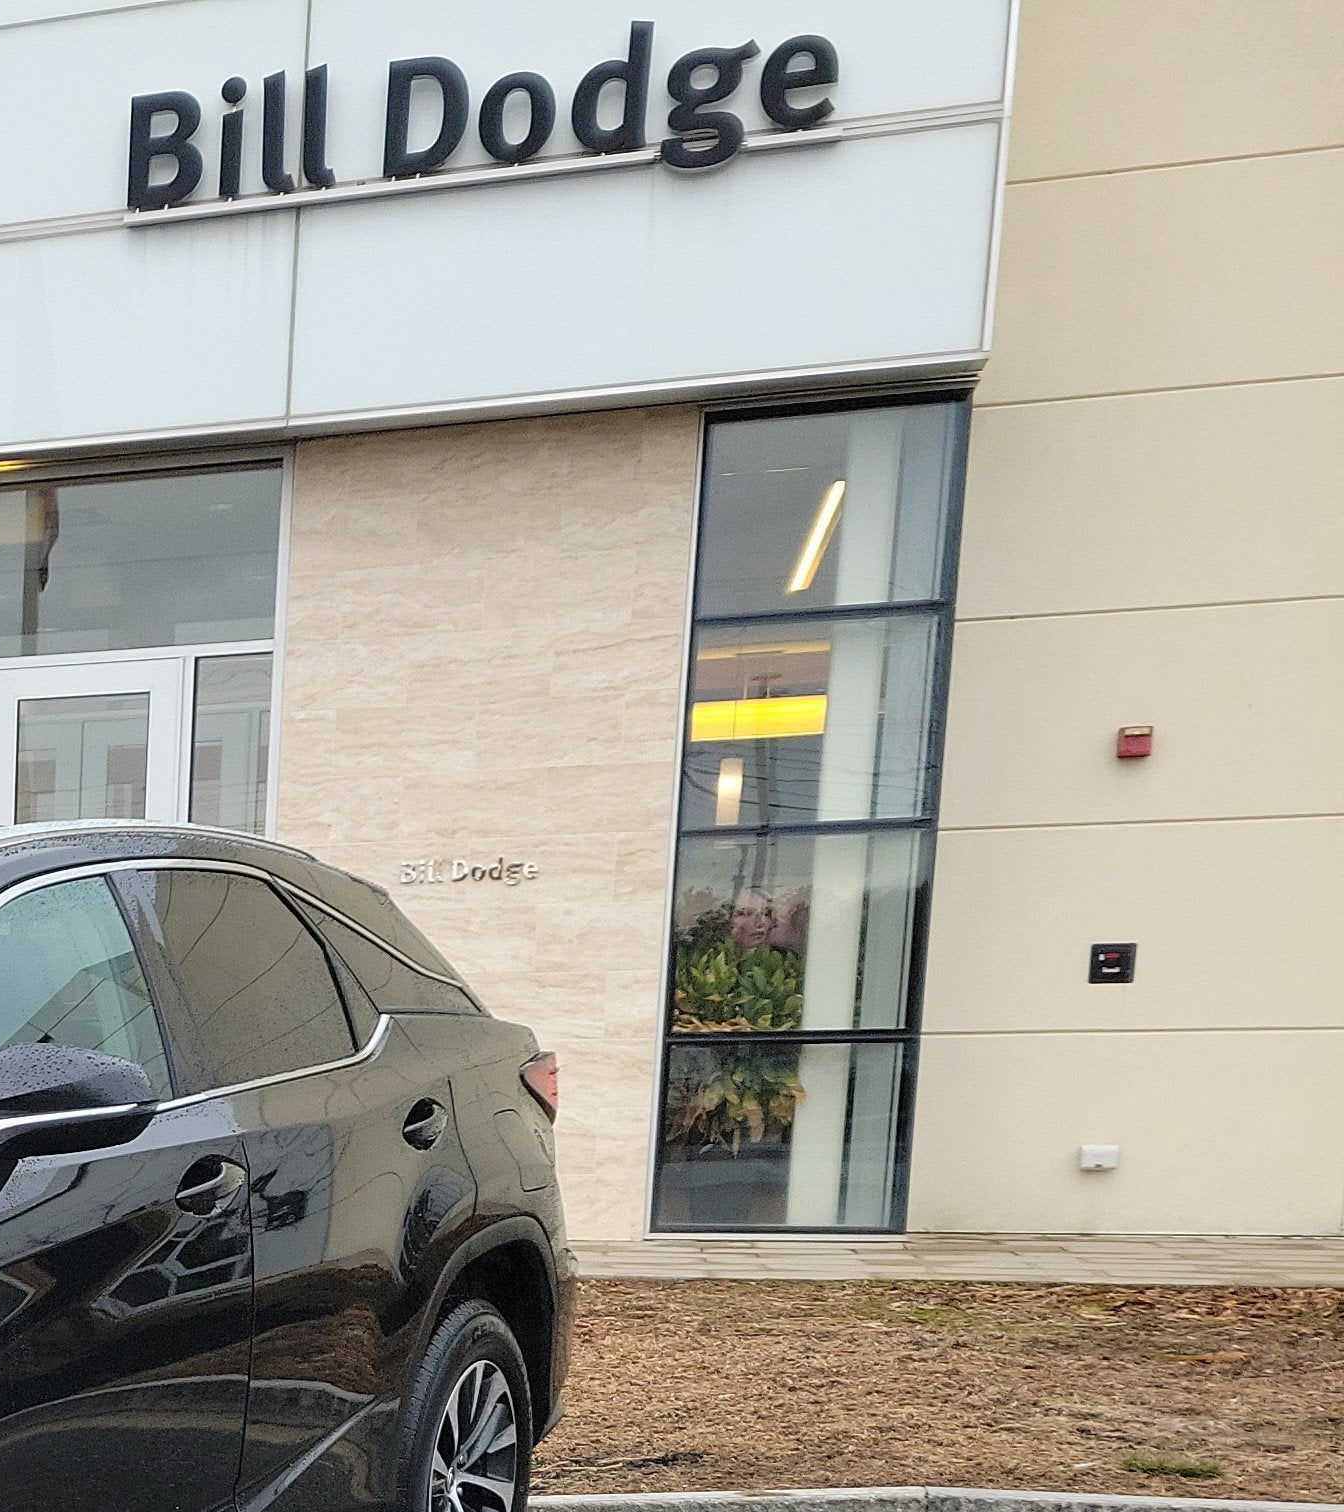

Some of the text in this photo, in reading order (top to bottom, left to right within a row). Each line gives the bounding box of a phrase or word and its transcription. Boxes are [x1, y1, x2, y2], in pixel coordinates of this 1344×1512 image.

[125, 20, 840, 211] Bill Dodge
[451, 857, 539, 886] Dodge
